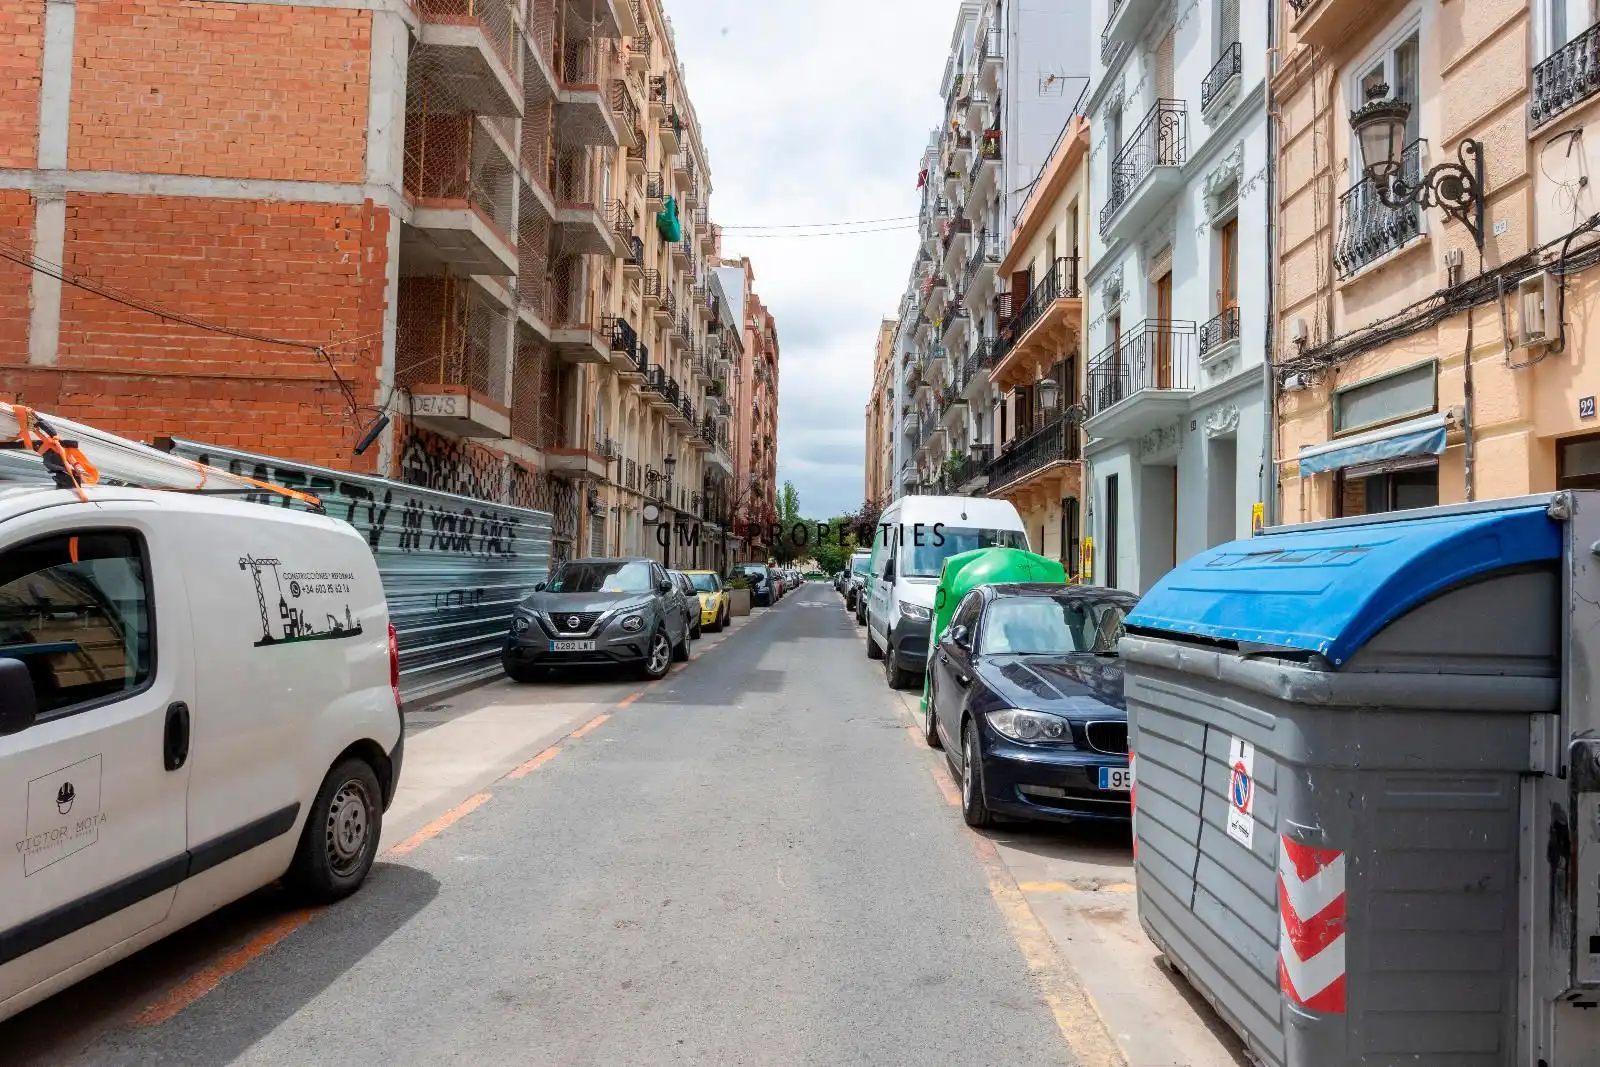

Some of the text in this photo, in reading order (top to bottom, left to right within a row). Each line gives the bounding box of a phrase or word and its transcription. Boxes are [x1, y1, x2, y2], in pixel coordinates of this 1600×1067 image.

[1580, 399, 1594, 417] 22
[429, 504, 473, 556] YOUR
[478, 510, 520, 558] FACE
[15, 825, 69, 853] VICTOR
[76, 812, 107, 833] MOTA
